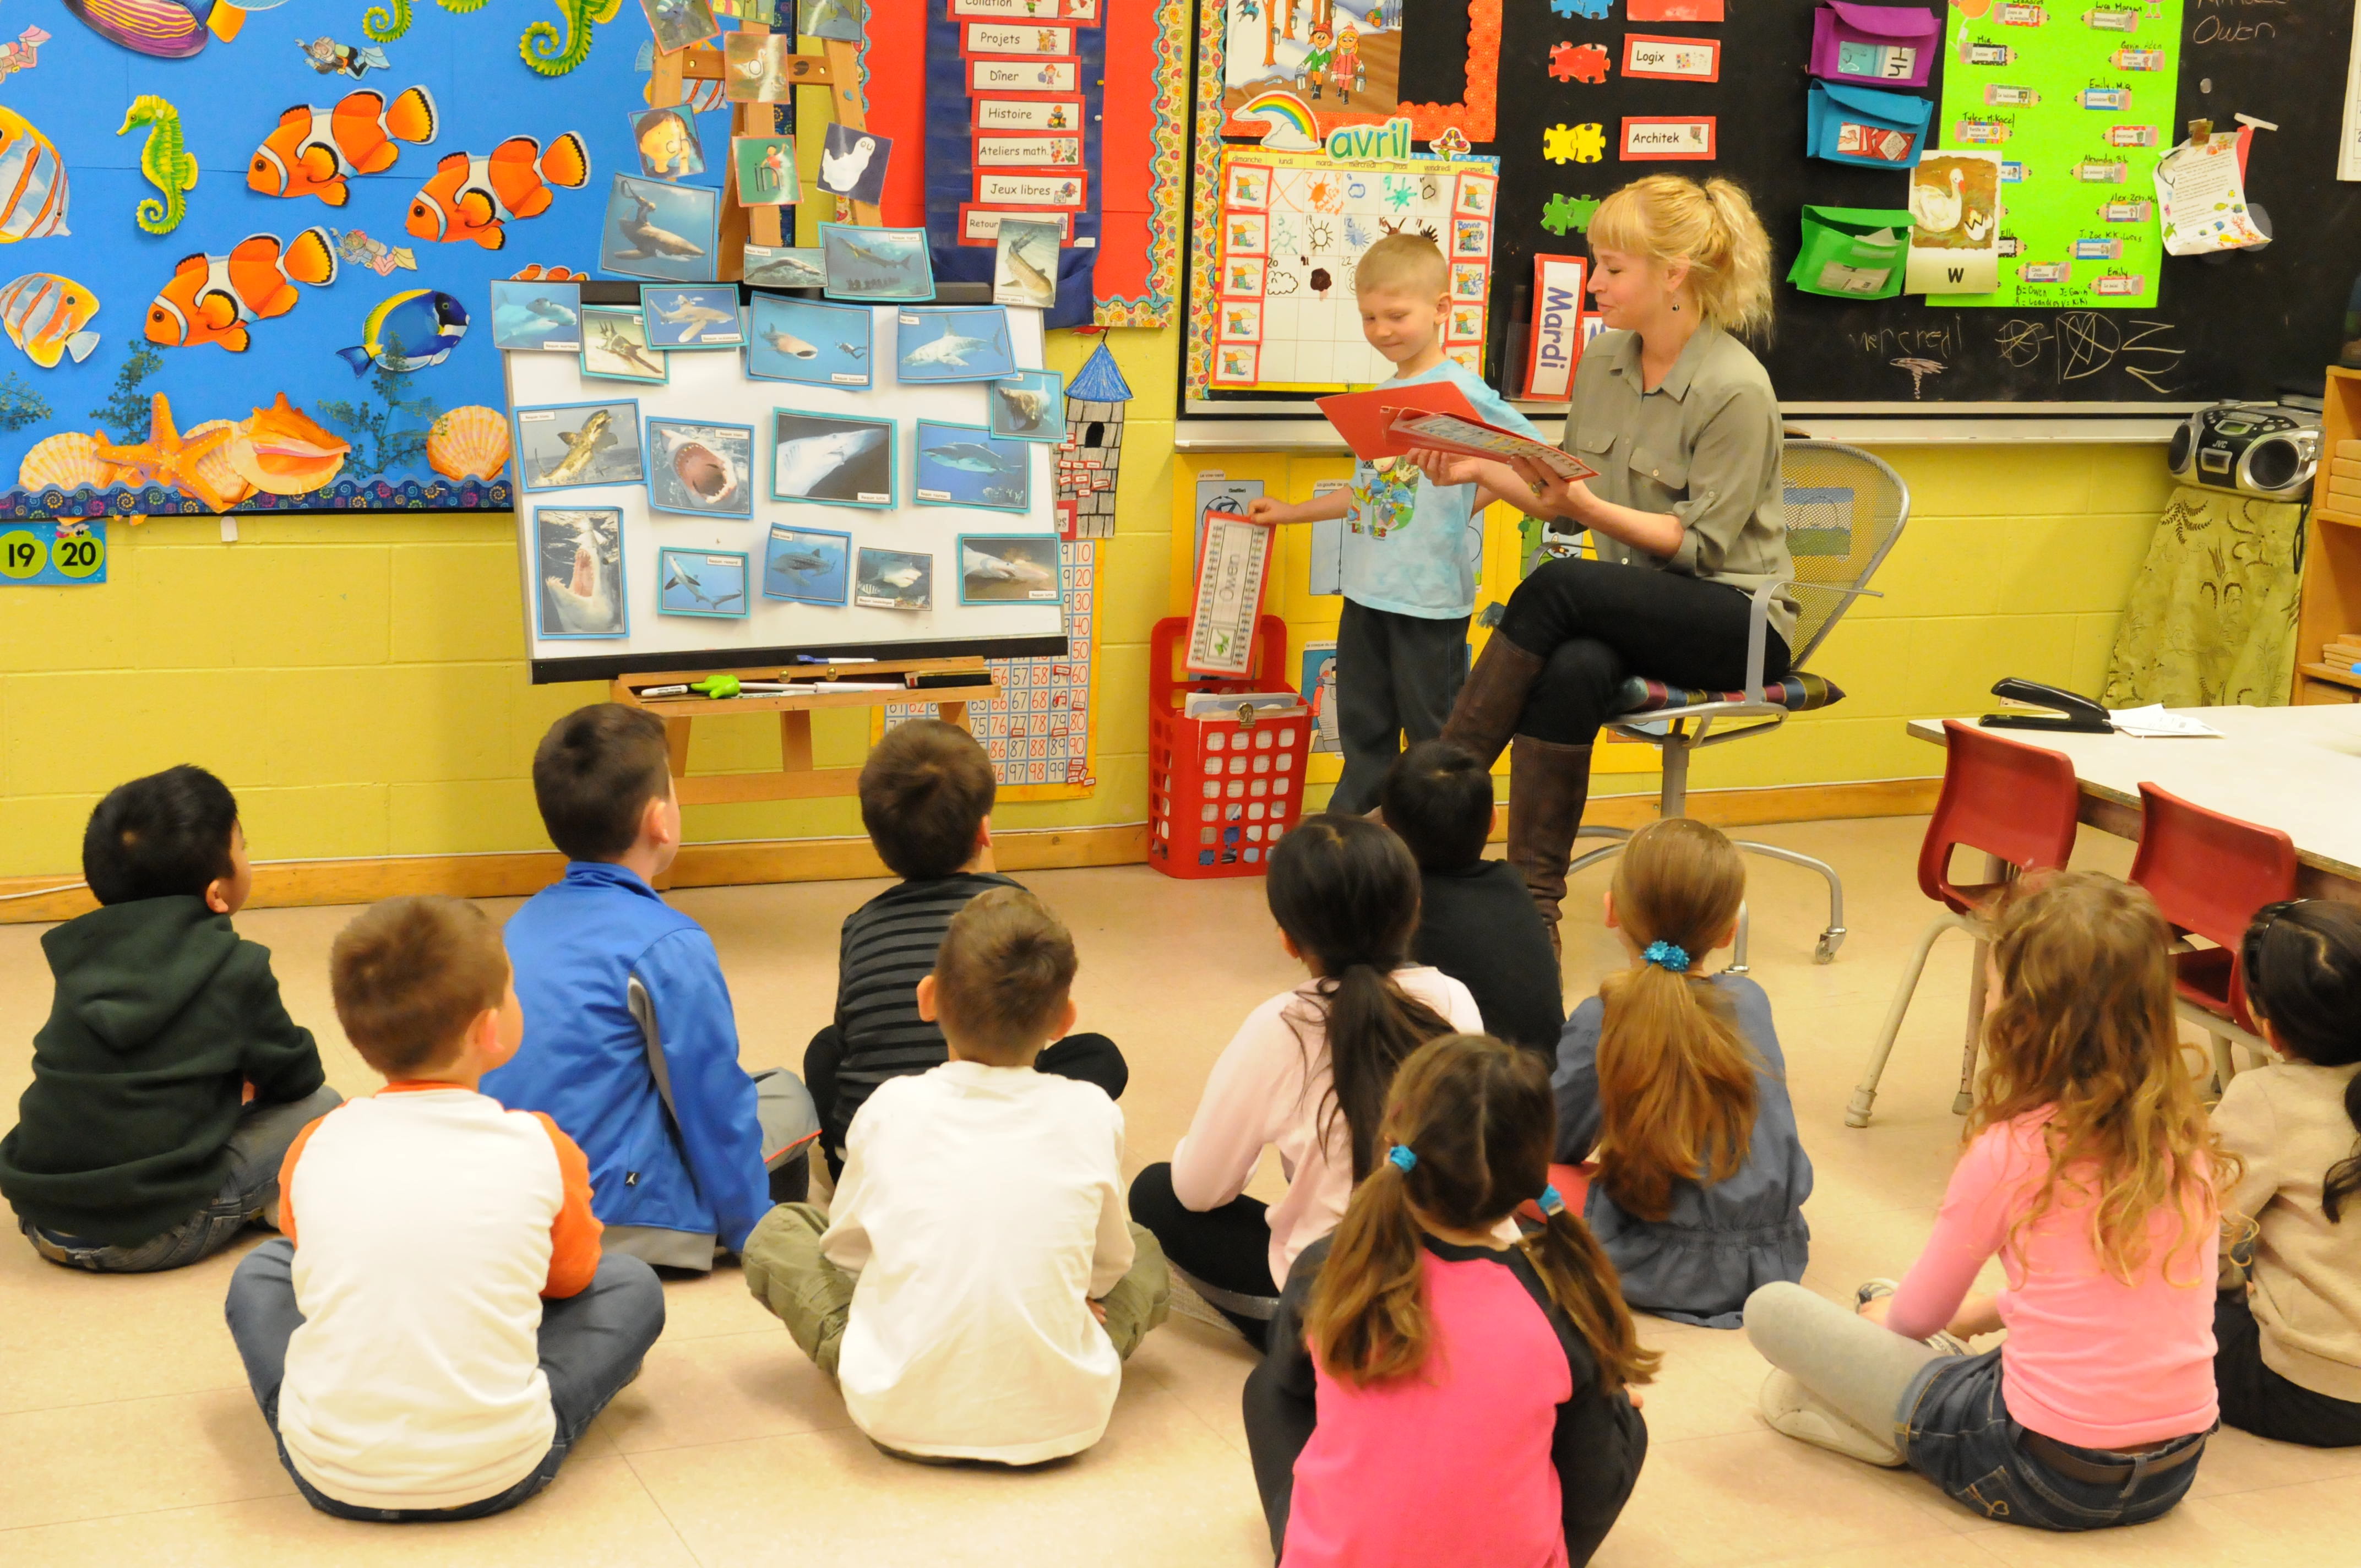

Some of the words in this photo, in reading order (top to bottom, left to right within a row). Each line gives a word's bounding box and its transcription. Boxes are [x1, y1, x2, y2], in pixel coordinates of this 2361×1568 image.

[981, 31, 1020, 47] Projets
[2193, 15, 2276, 45] Owen
[1636, 50, 1665, 65] Logix
[990, 70, 1019, 81] Dîner
[988, 107, 1032, 119] Histoire
[1331, 123, 1408, 159] avril
[1633, 132, 1680, 144] Architek
[980, 145, 1020, 156] Ateliers
[1023, 145, 1049, 156] math.
[1232, 155, 1263, 164] dimanche
[1424, 164, 1451, 172] vendredi
[990, 183, 1018, 194] Jeux
[1021, 183, 1051, 195] libres
[970, 219, 999, 228] Retour
[1541, 286, 1574, 369] Mardi
[2212, 440, 2228, 449] JVC
[9, 543, 36, 568] 19
[61, 541, 96, 567] 20
[1076, 544, 1091, 562] 10
[1075, 569, 1091, 586] 20
[1074, 593, 1091, 611] 30
[1074, 617, 1090, 635] 40
[1073, 641, 1089, 660] 50
[992, 668, 1009, 686] 56
[1012, 667, 1029, 685] 57
[1032, 667, 1049, 685] 58
[1072, 665, 1088, 684] 60
[992, 693, 1008, 710] 66
[1012, 692, 1028, 710] 67
[1031, 691, 1048, 709] 68
[1071, 689, 1087, 705] 70
[971, 717, 987, 735] 75
[991, 717, 1007, 734] 76
[1011, 716, 1027, 729] 77
[1031, 715, 1047, 733] 78
[1052, 714, 1067, 729] 79
[1069, 713, 1086, 731] 80
[990, 741, 1006, 759] 86
[1010, 740, 1026, 758] 87
[1030, 739, 1046, 756] 88
[1050, 738, 1066, 756] 89
[1069, 737, 1085, 754] 90
[1009, 763, 1026, 781] 97
[1029, 763, 1045, 780] 98
[1049, 762, 1065, 779] 99
